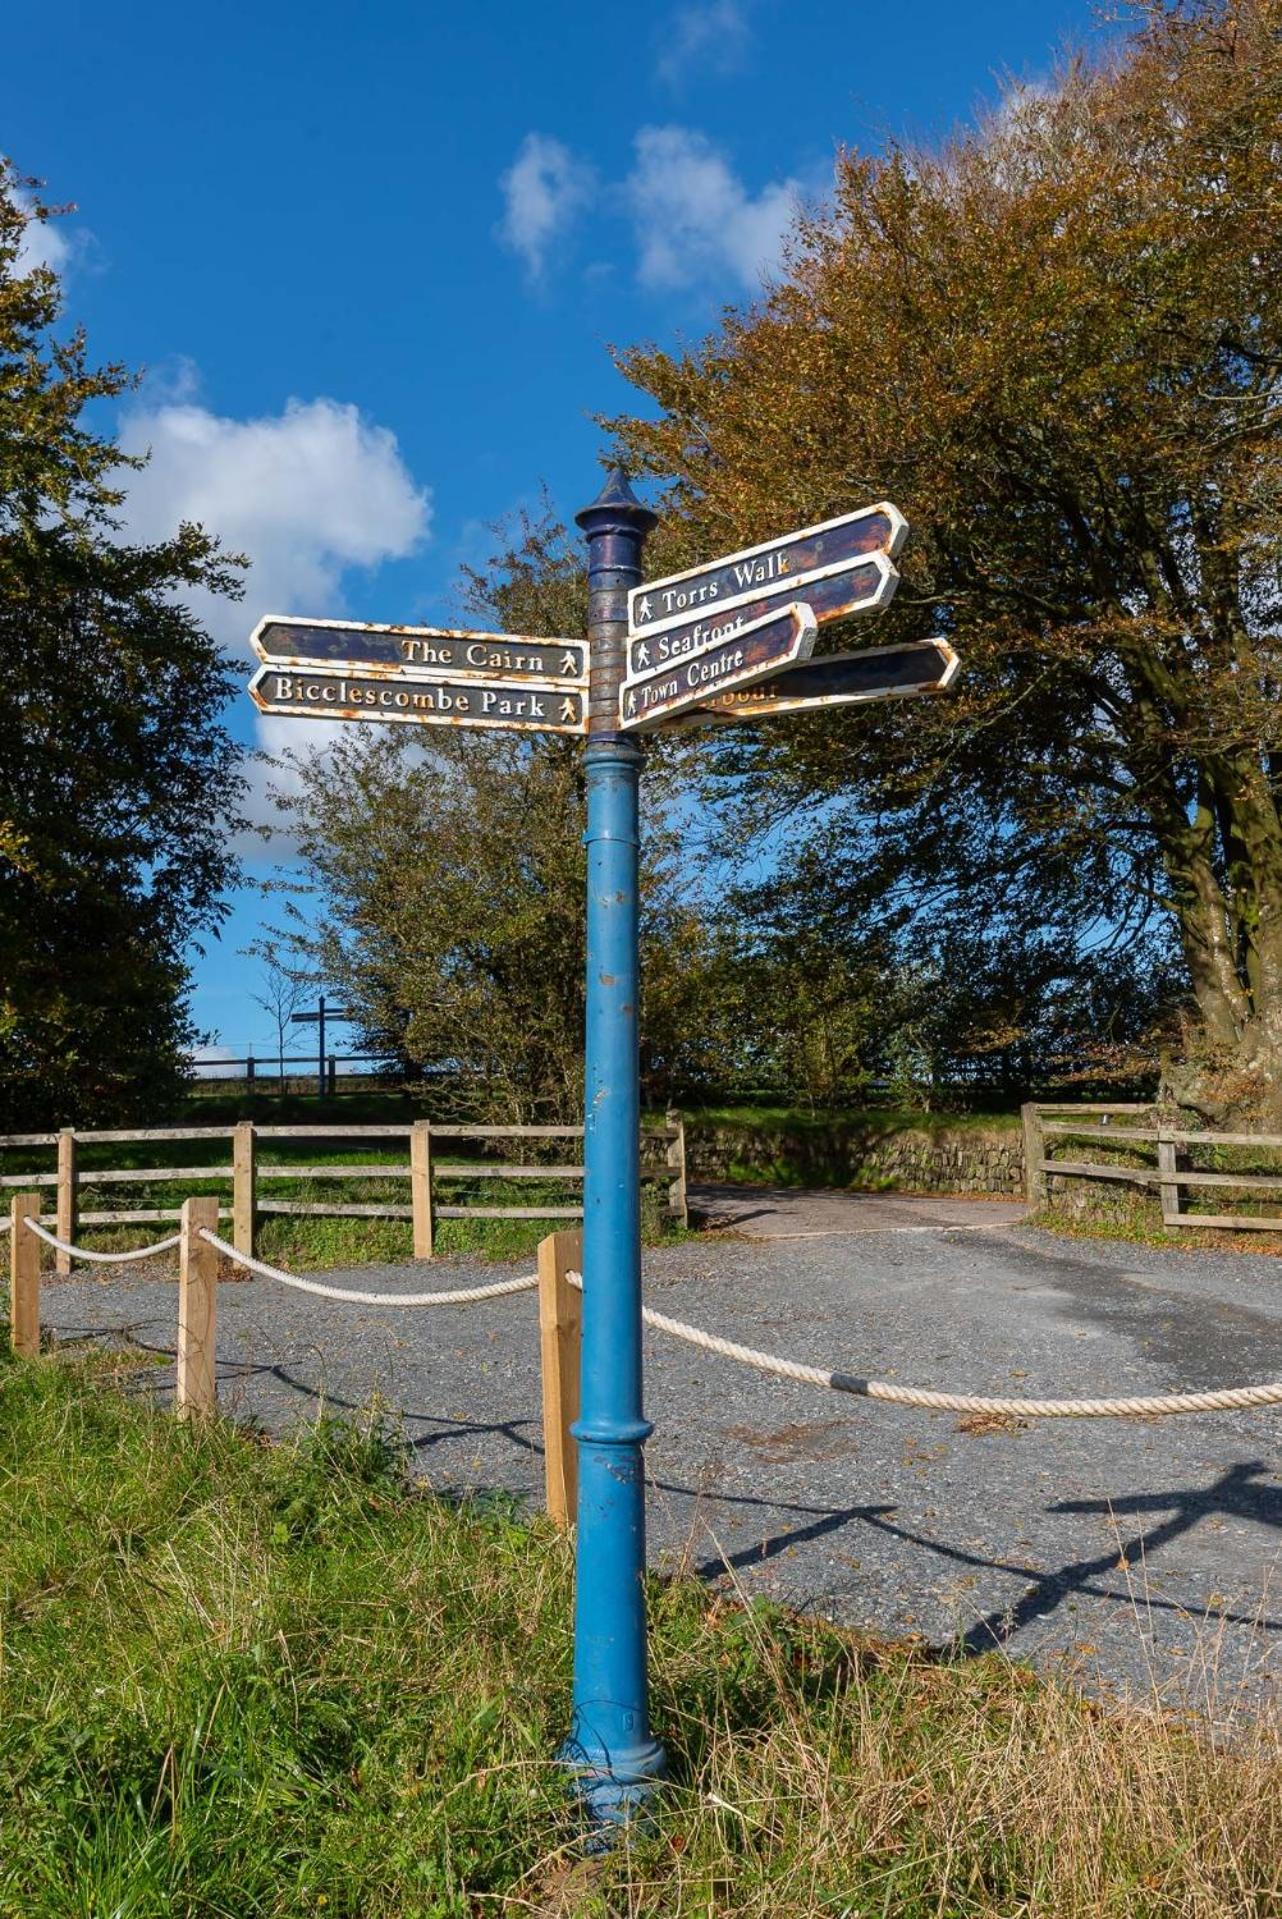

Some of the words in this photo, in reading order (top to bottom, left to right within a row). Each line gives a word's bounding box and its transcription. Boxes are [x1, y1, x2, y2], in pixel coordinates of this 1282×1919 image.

[662, 581, 719, 613] Torrs
[733, 551, 791, 588] Walk
[401, 639, 452, 664] The
[466, 643, 544, 672] Cairn
[658, 615, 744, 661] Seafront
[274, 677, 470, 711] Bicclescombe
[480, 690, 545, 717] Park
[641, 680, 678, 709] Town
[686, 649, 743, 687] Centre
